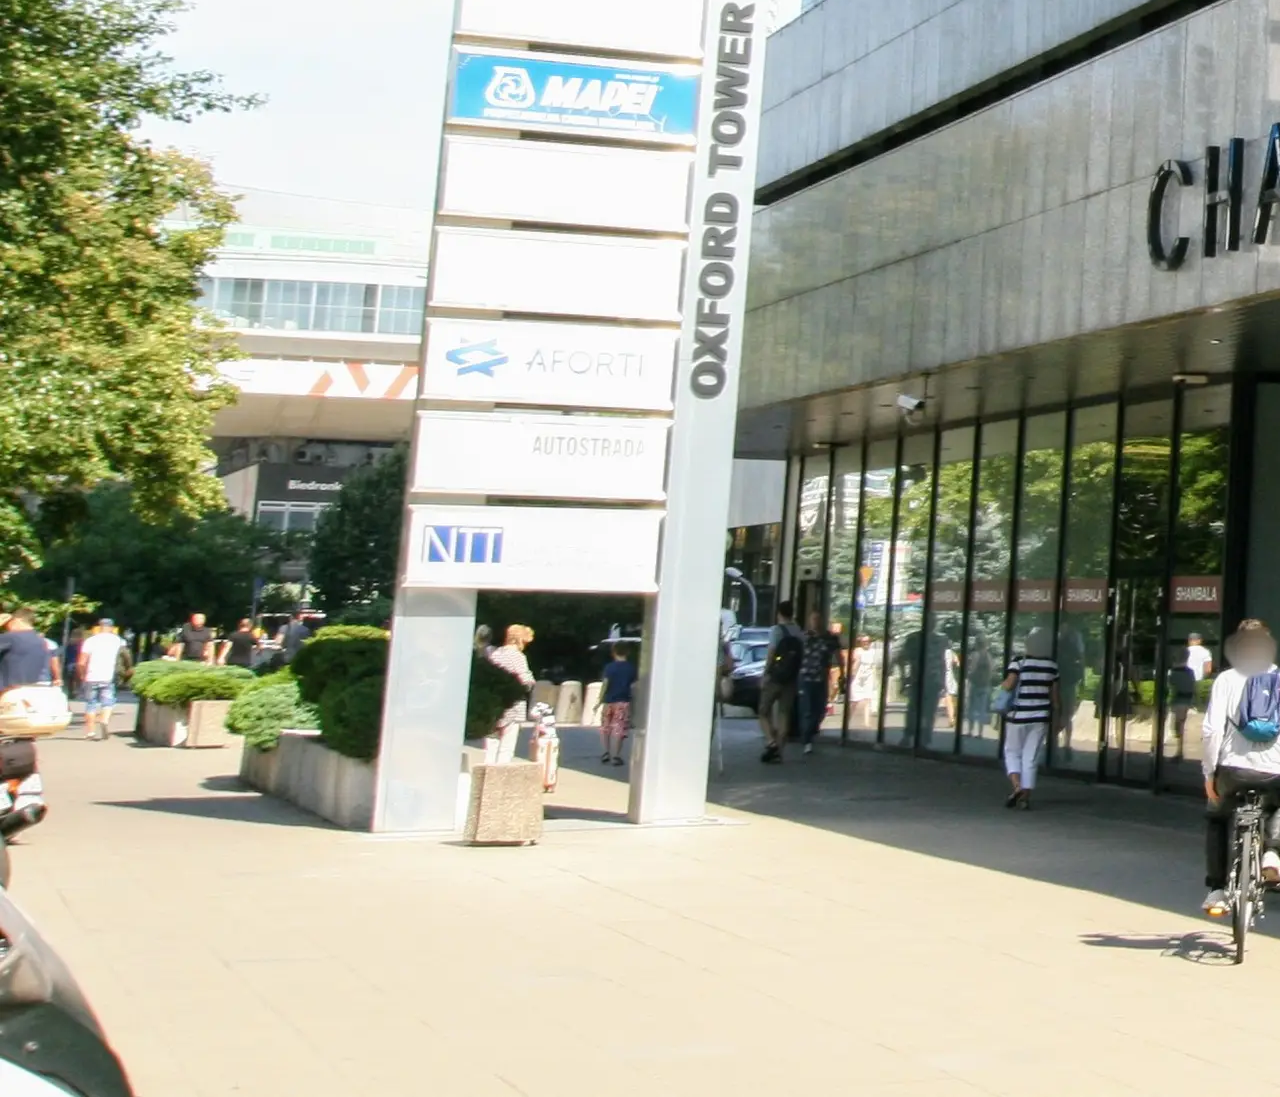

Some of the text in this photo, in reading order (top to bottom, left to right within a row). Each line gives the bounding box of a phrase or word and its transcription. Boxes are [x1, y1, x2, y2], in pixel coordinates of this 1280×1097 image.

[540, 75, 658, 115] MAPEI
[690, 1, 756, 399] OXFORD TOWER
[525, 348, 646, 377] AFORTI
[532, 435, 645, 458] AUTOSTRADA
[422, 524, 504, 565] NTT
[1174, 585, 1217, 602] SHAMBALA
